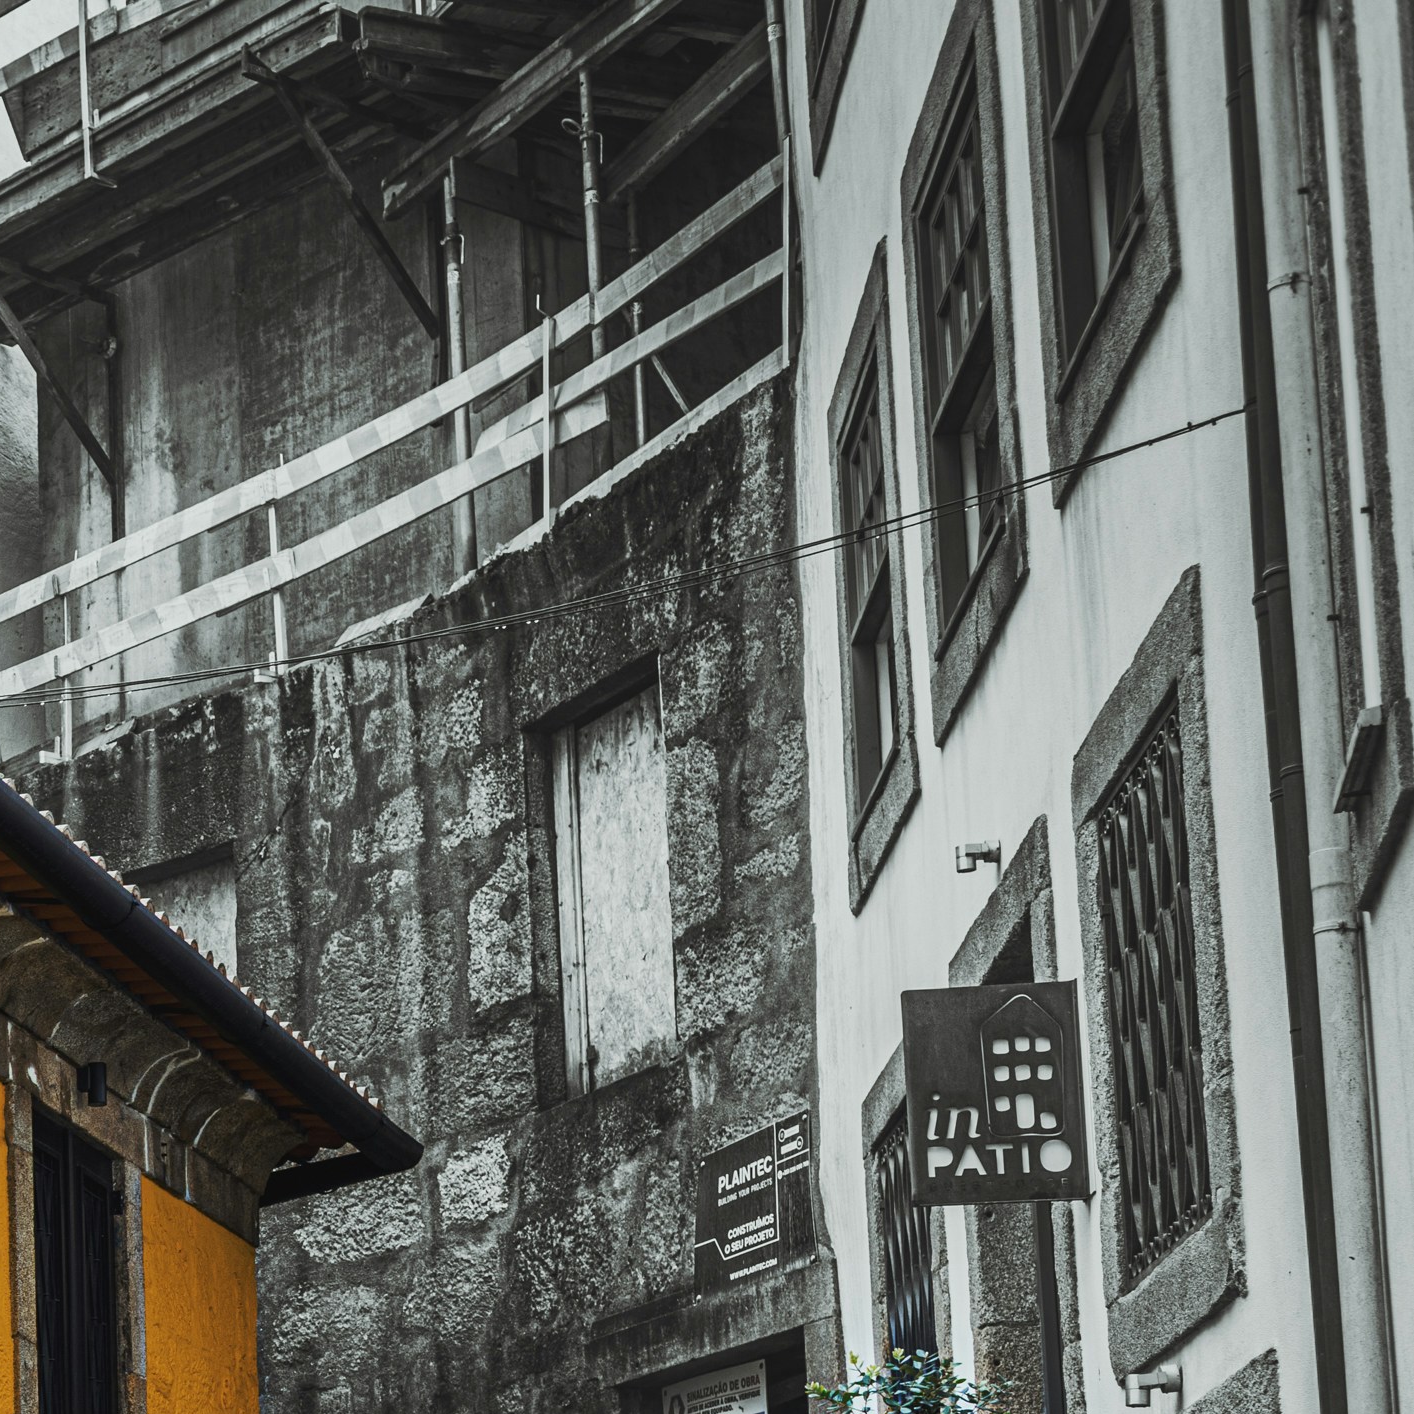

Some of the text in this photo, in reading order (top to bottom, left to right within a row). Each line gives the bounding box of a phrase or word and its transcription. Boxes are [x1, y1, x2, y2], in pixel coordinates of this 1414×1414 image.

[926, 1092, 981, 1140] in
[718, 1155, 772, 1193] PLAINTEC
[927, 1139, 1072, 1178] PATIO
[724, 1227, 774, 1254] O SEU PROJETO
[727, 1213, 774, 1239] CONSTRUÍMOS
[687, 1374, 760, 1402] SINALIZAÇÃO DE OBRA
